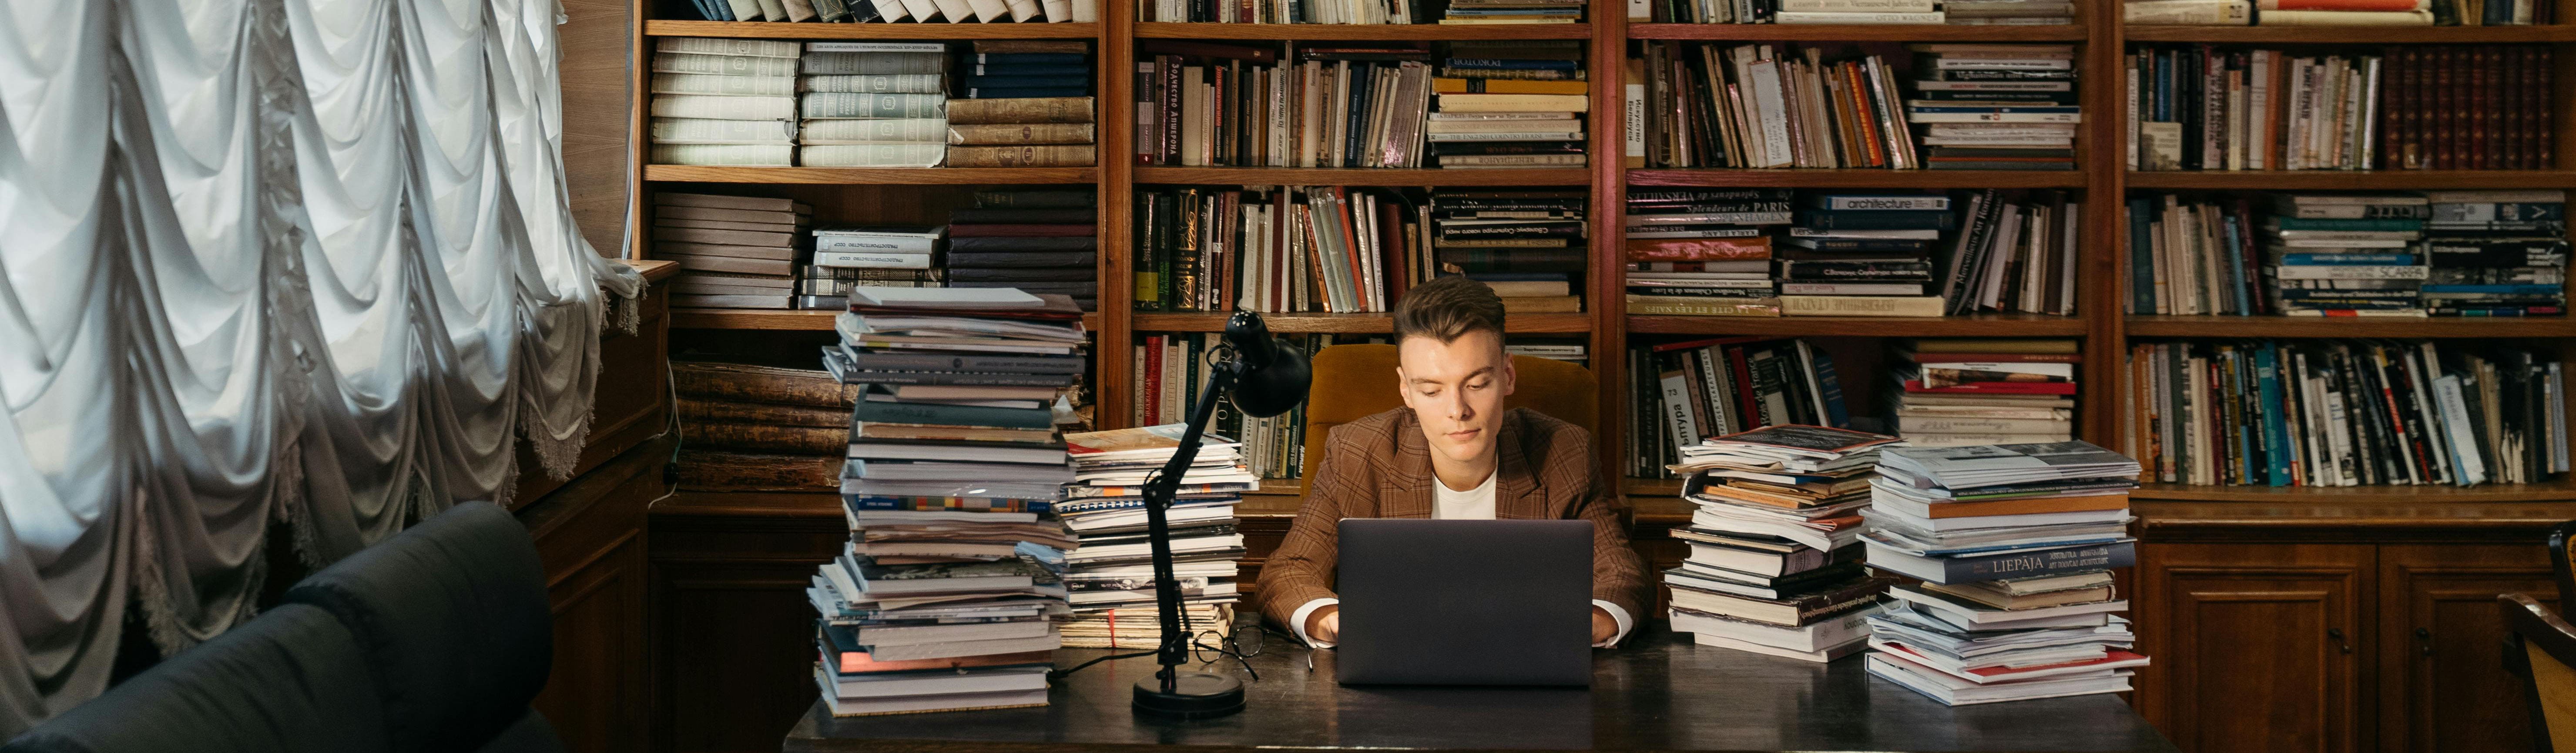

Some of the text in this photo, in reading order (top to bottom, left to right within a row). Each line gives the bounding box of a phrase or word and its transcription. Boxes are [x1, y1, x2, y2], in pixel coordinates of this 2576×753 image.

[1627, 191, 1694, 202] VERSAILLES
[1710, 191, 1759, 199] Splendeurs
[1687, 204, 1736, 213] Splendeurs
[1753, 202, 1790, 212] PARIS
[1847, 198, 1912, 208] architecture
[1955, 188, 1996, 284] Merveilleux Art Roman
[1711, 306, 1733, 314] CITÉ
[1746, 357, 1770, 424] Rois de France
[1674, 404, 1690, 448] ьптура
[1714, 405, 1726, 435] IPZIGER
[1993, 555, 2043, 573] LIEPĀJA
